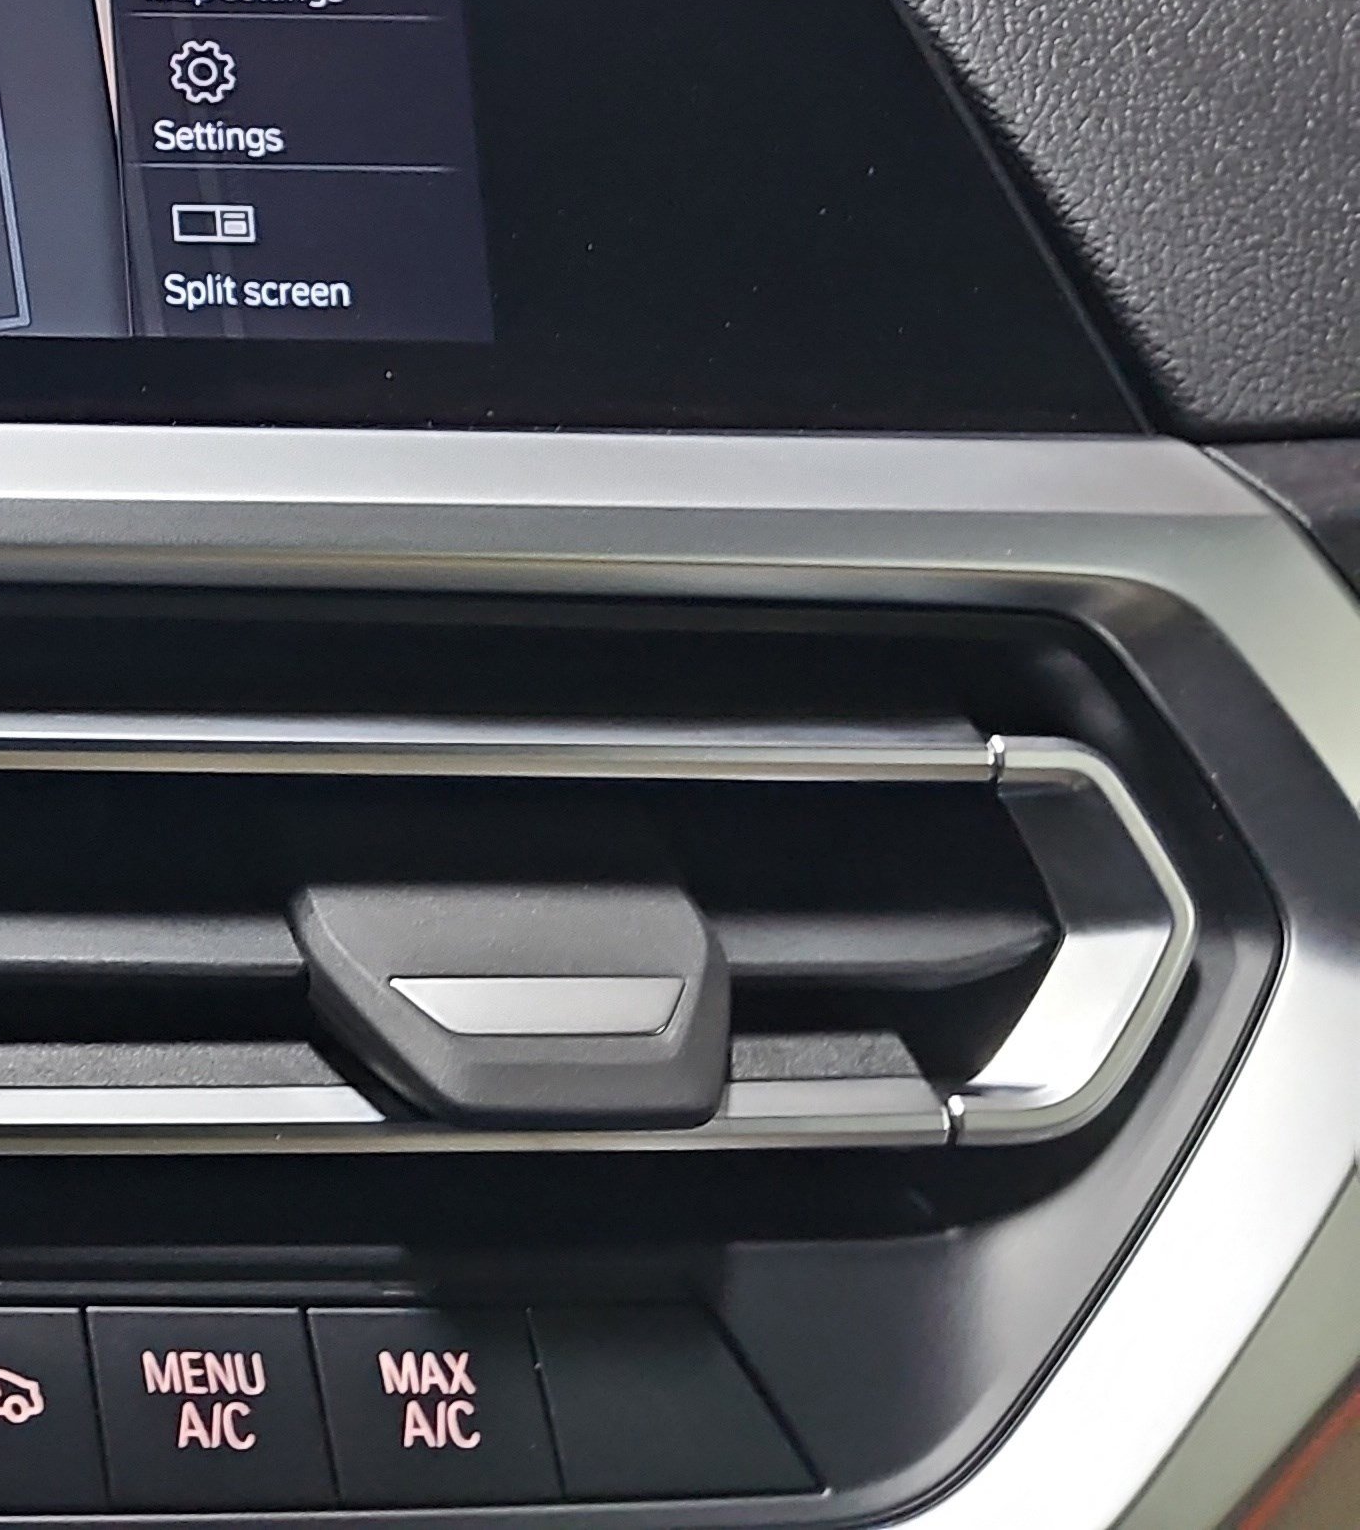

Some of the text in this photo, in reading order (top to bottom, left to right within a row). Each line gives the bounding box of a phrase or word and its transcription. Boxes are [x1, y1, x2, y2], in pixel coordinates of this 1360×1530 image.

[153, 119, 285, 157] Settings
[164, 273, 352, 310] Split screen
[141, 1351, 265, 1397] MENU
[378, 1351, 476, 1396] MAX
[176, 1401, 256, 1450] A/C
[402, 1401, 480, 1450] A/C
